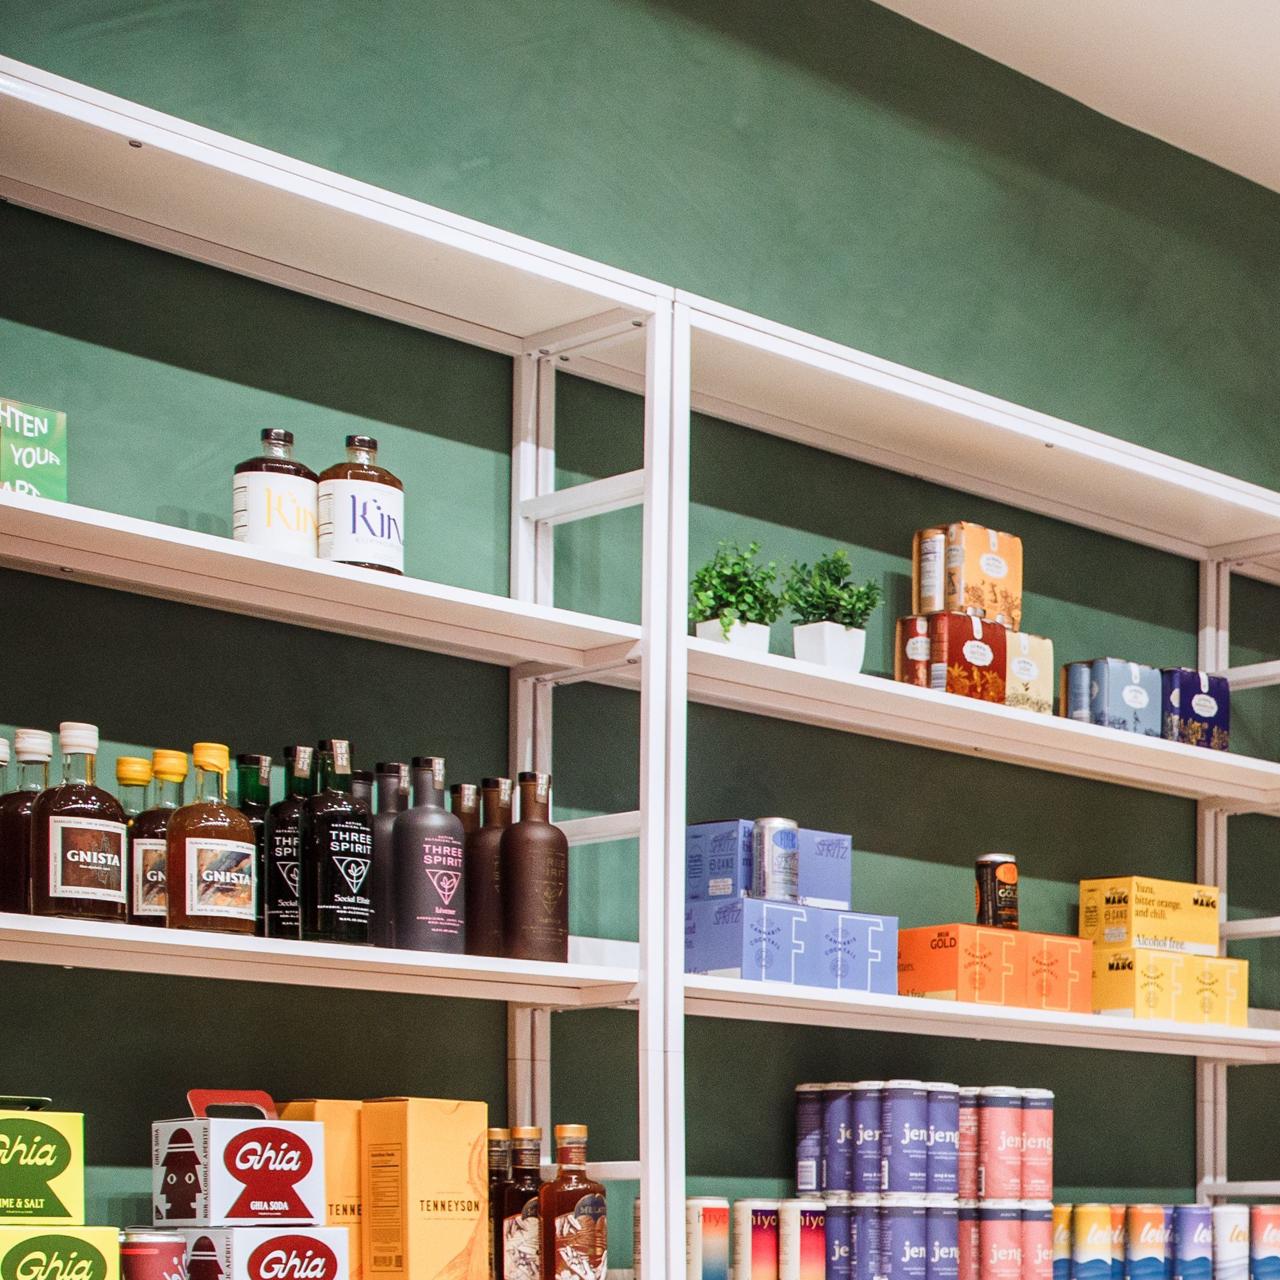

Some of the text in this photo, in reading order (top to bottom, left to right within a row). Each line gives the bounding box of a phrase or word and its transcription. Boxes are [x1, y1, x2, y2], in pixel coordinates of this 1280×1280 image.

[11, 444, 61, 469] YOUR
[329, 830, 372, 844] THREE
[329, 841, 372, 854] SPIRIT
[423, 844, 463, 858] THREE
[66, 849, 120, 867] GNISTA
[423, 855, 462, 868] SPIRIT
[201, 870, 251, 885] GNISTA
[930, 937, 957, 949] GOLD
[235, 1141, 302, 1172] Ghia
[24, 1199, 45, 1209] SALT
[419, 1200, 480, 1212] TENNEYSON
[260, 1250, 326, 1280] Ghia
